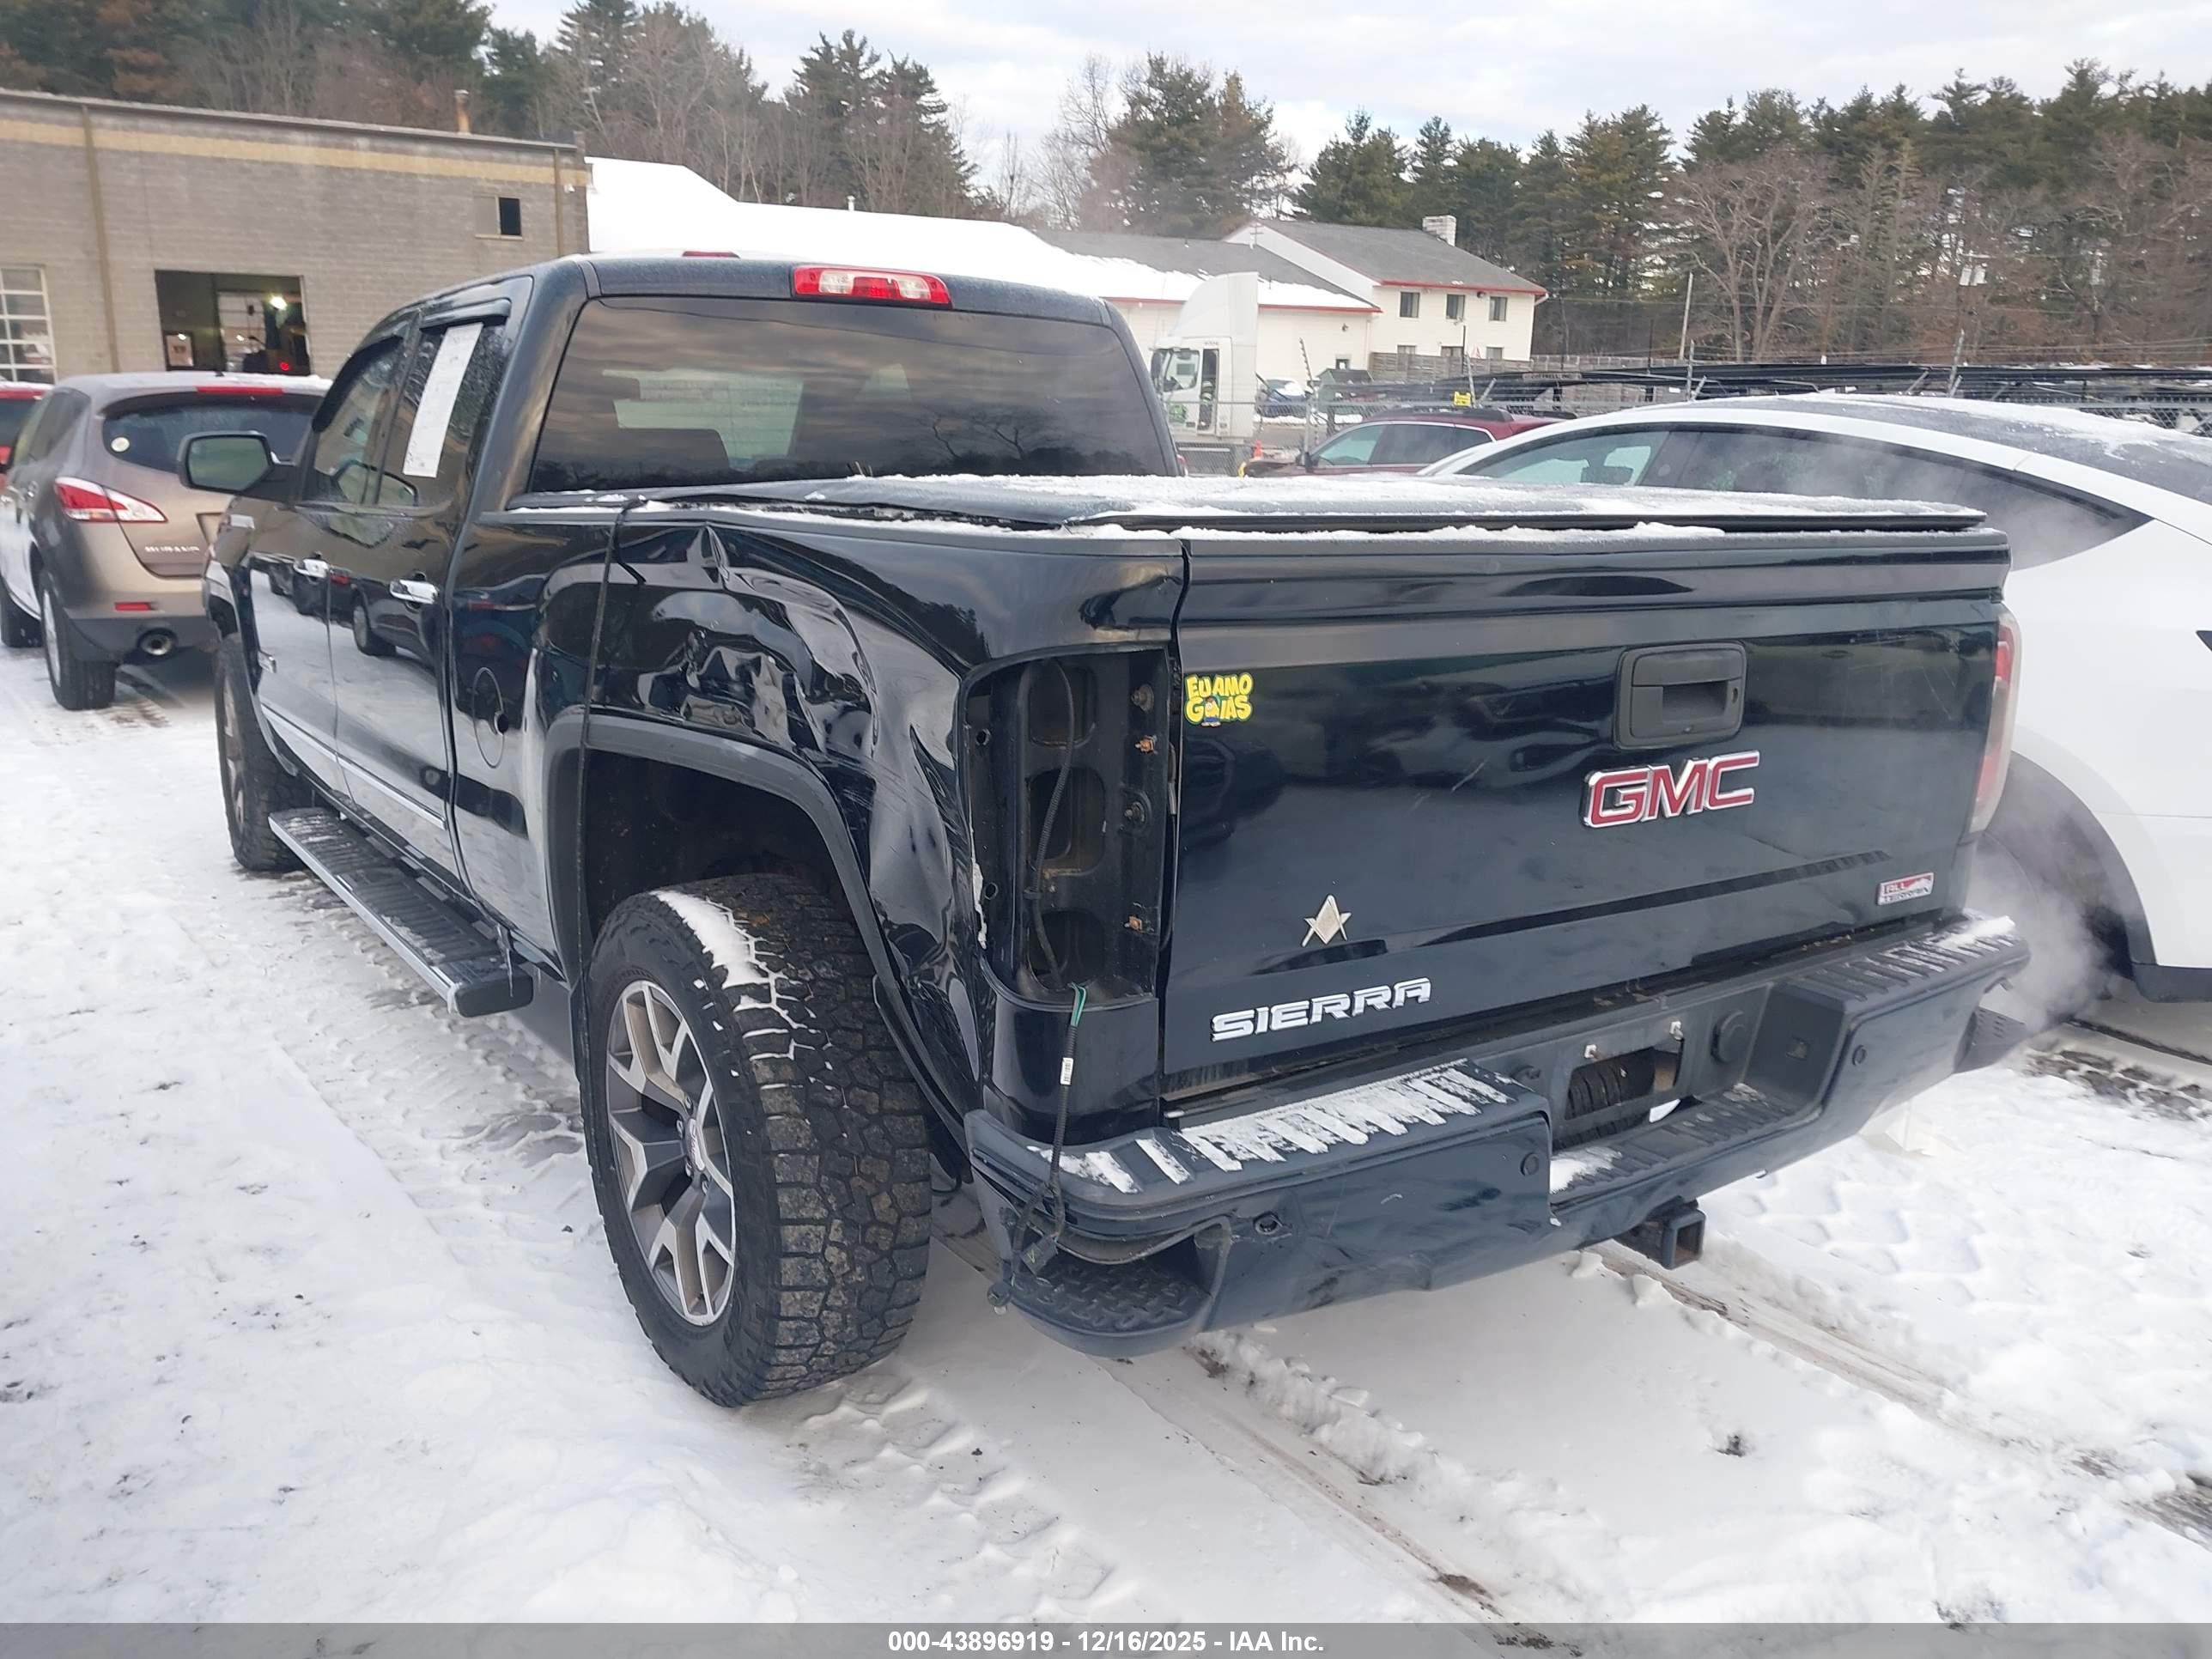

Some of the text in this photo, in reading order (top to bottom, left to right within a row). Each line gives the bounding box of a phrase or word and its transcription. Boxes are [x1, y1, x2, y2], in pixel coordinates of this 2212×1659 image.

[1186, 672, 1253, 699] EU AMO
[1582, 750, 1760, 829] GMC
[1211, 976, 1432, 1042] SIERRA
